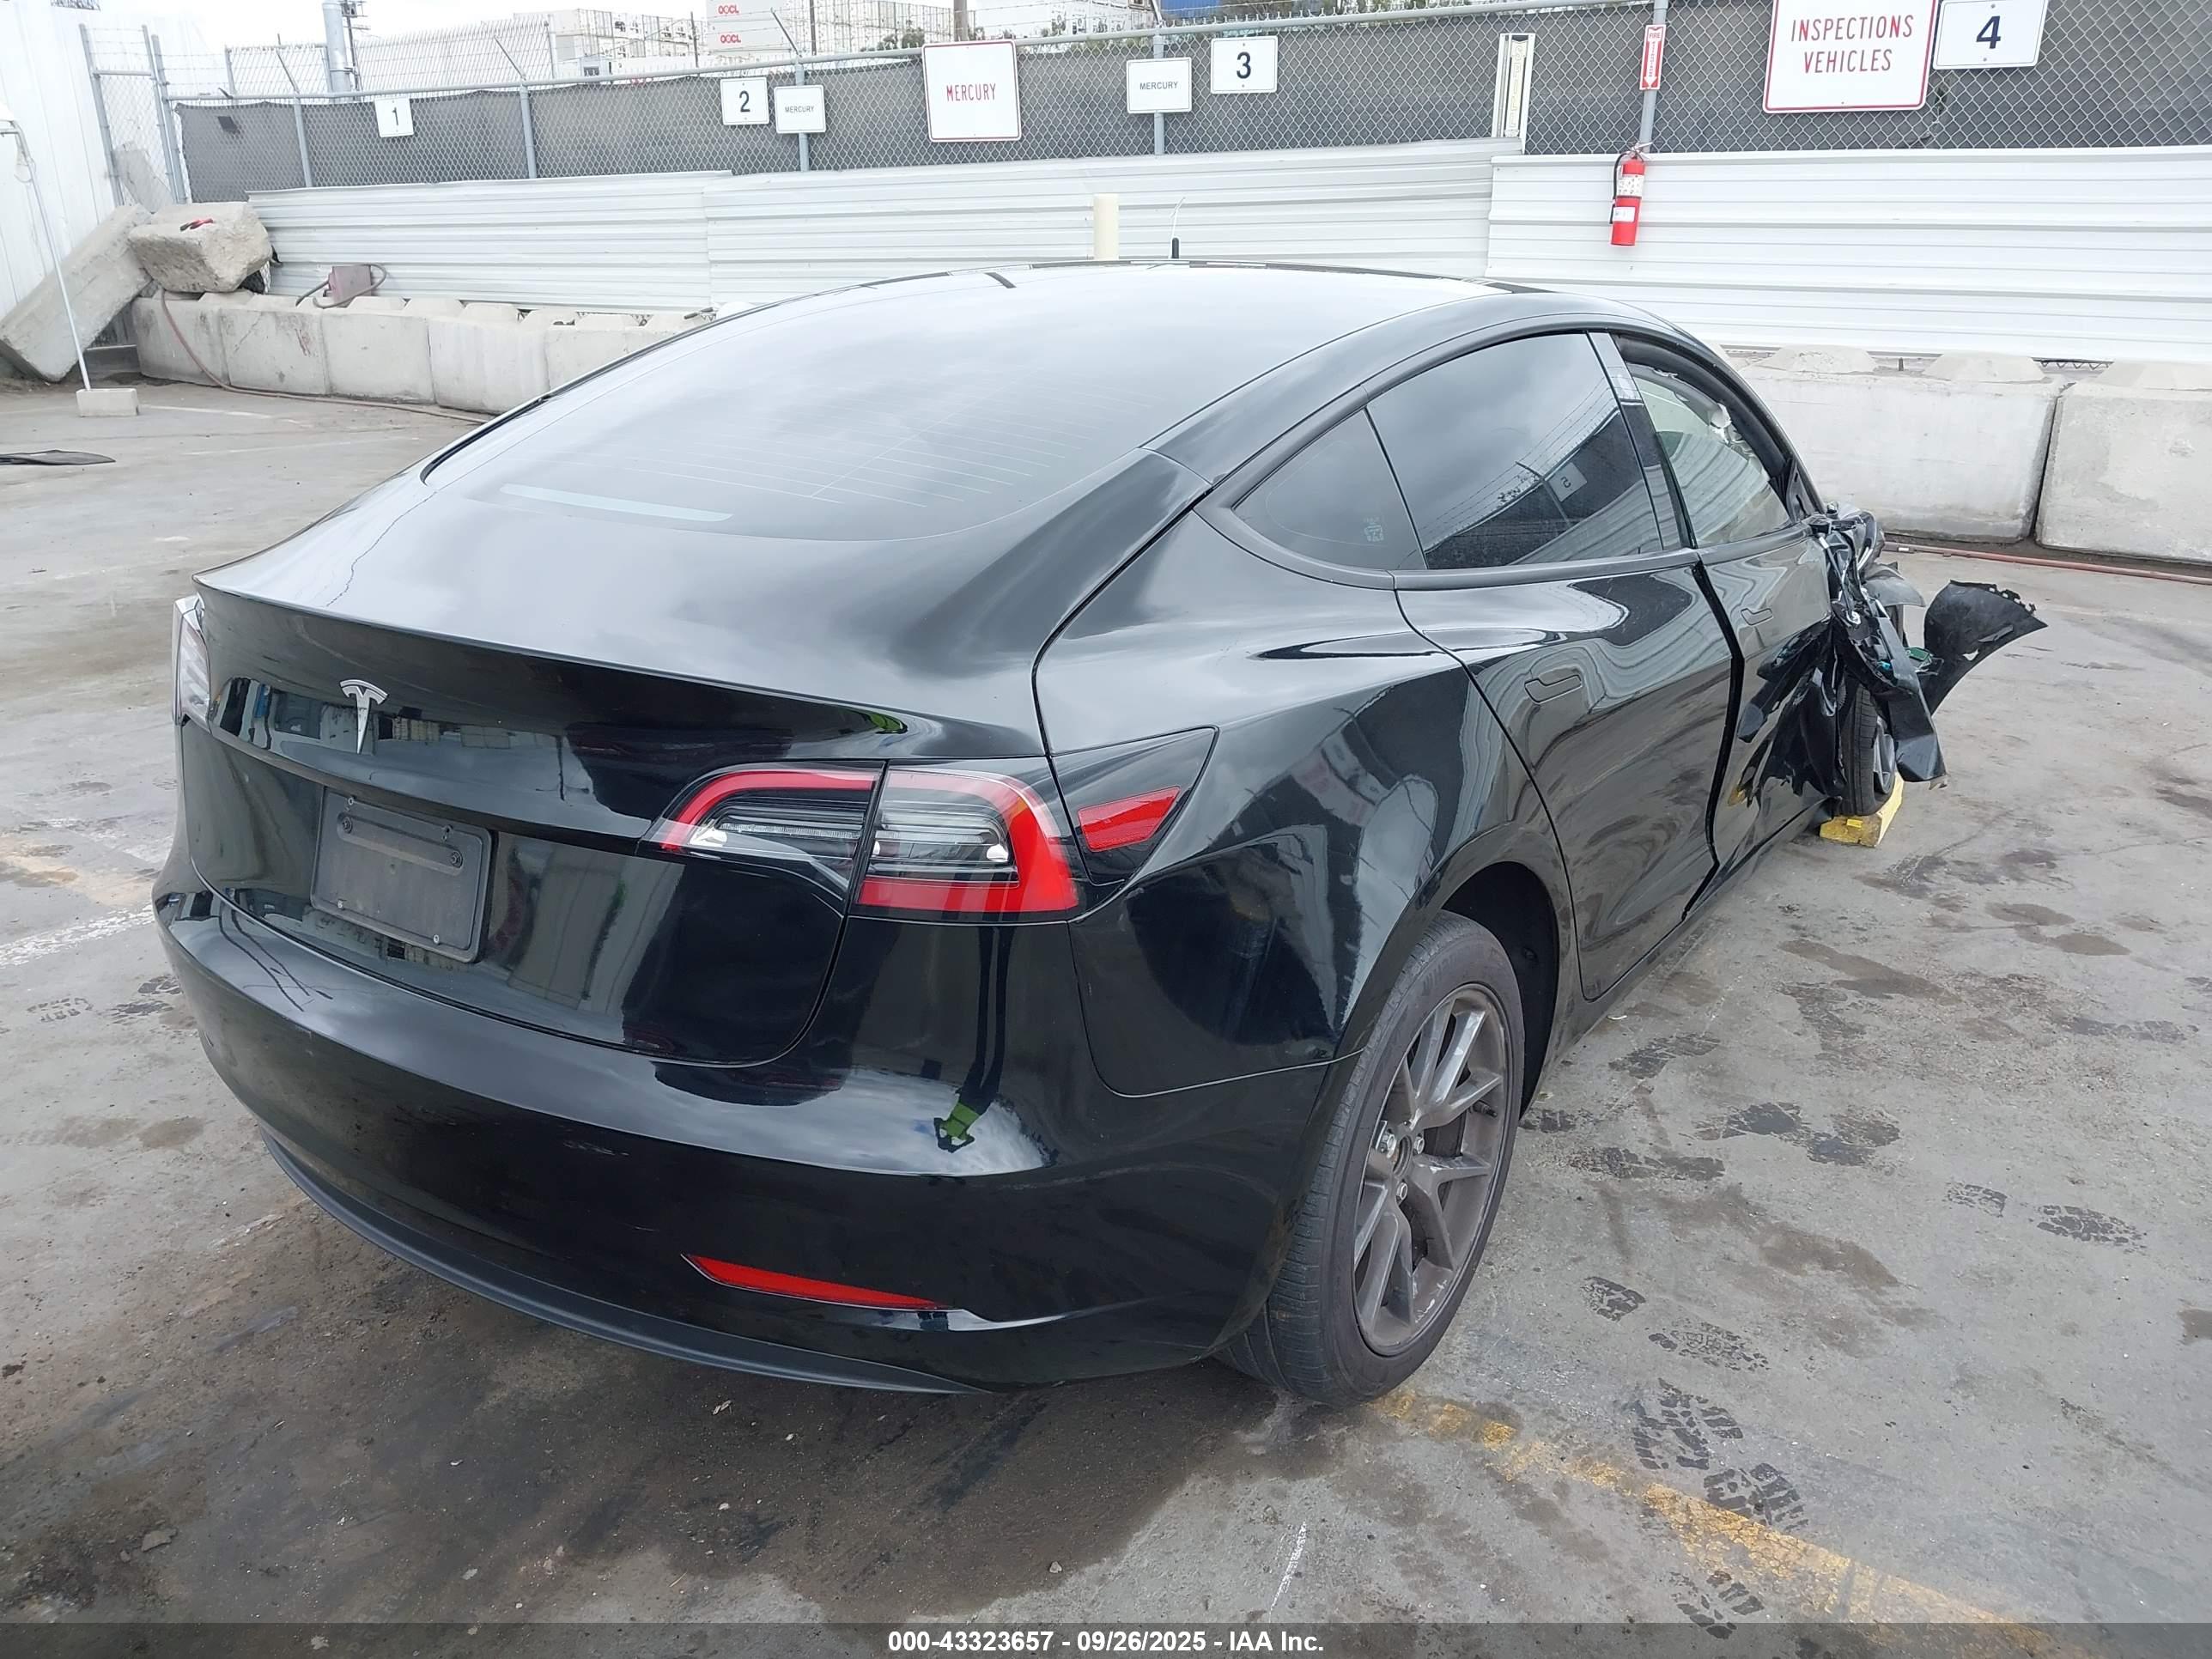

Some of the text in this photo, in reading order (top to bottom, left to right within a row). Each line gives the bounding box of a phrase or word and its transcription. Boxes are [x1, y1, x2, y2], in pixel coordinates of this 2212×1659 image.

[1791, 15, 1914, 42] INSPECTIONS
[1975, 15, 2002, 50] 4
[1236, 52, 1252, 80] 3
[1805, 49, 1893, 74] VEHICLES
[945, 82, 997, 102] MERCURY
[1139, 81, 1179, 90] MERCURY
[738, 90, 751, 113] 2
[784, 105, 815, 113] MERCURY
[391, 106, 399, 126] 1
